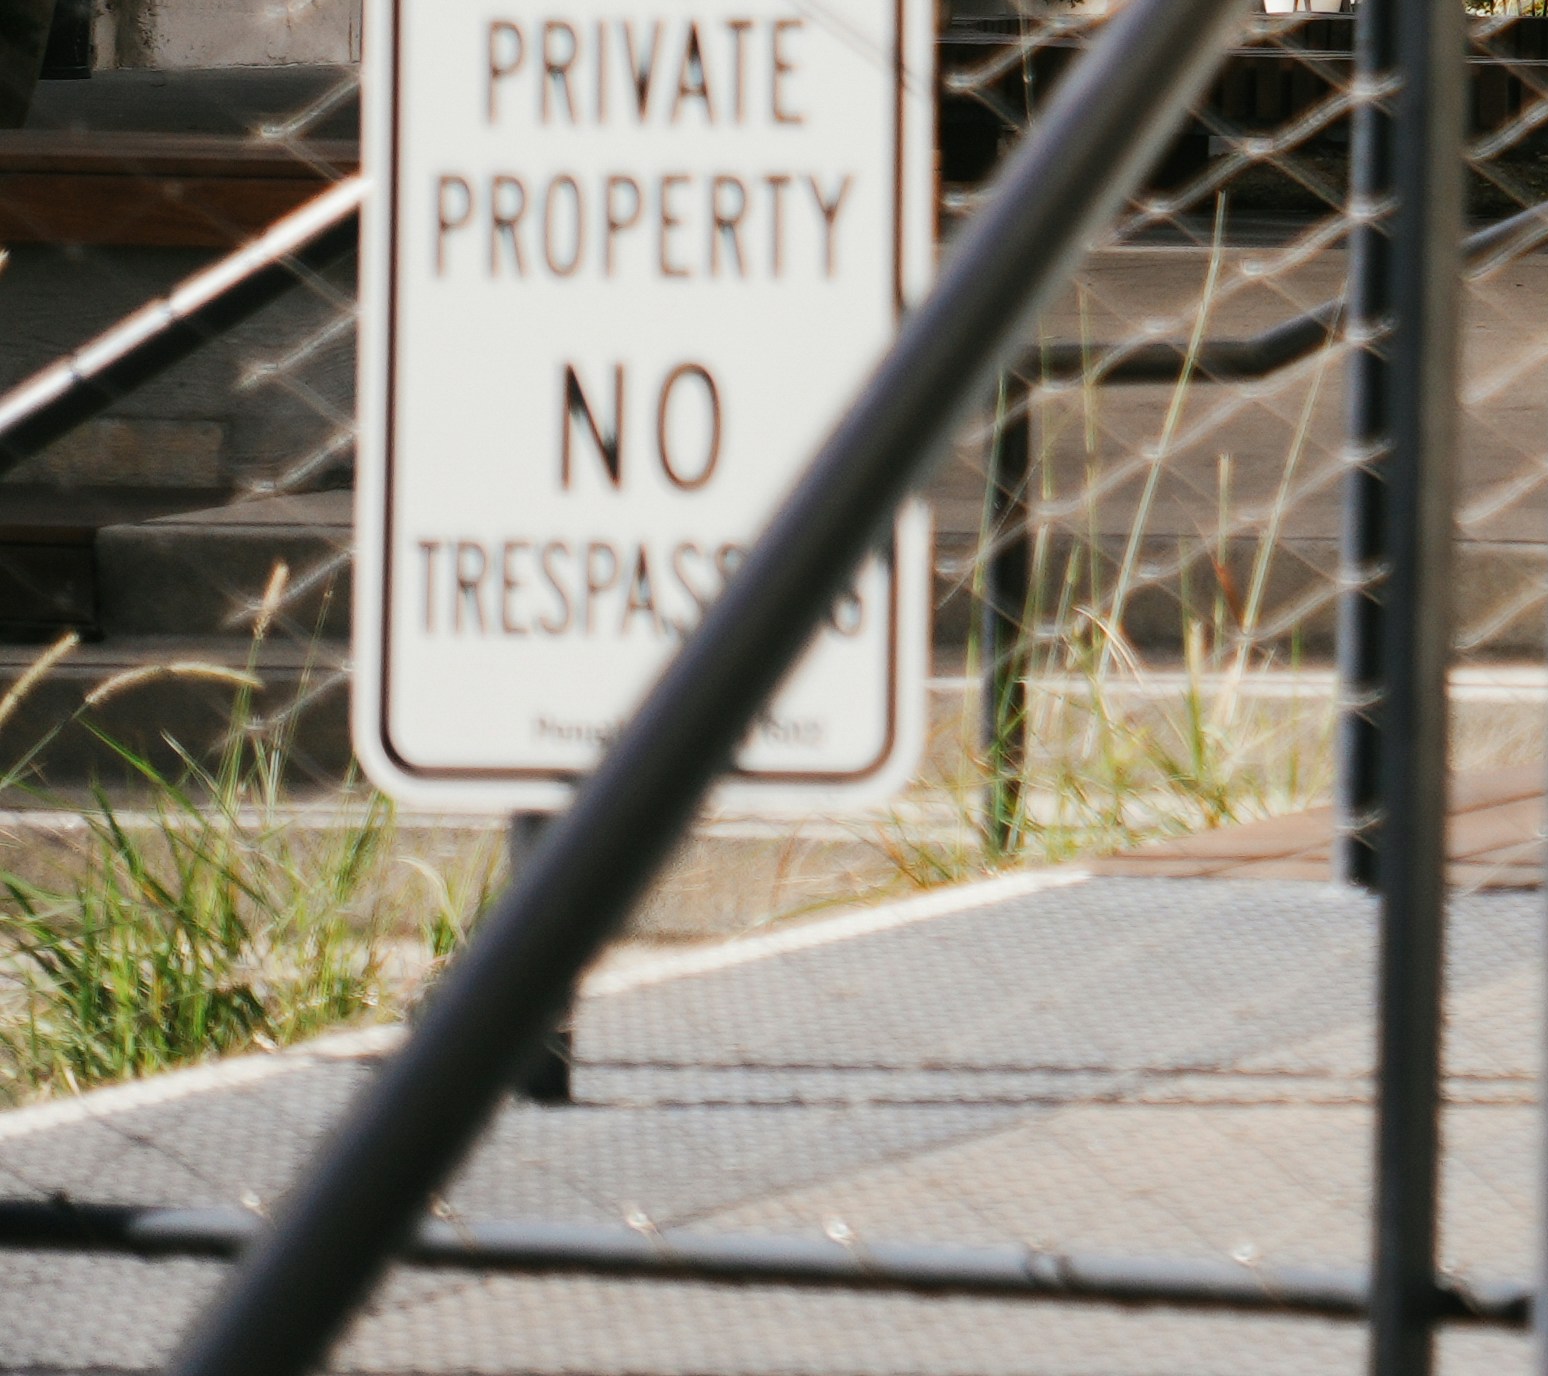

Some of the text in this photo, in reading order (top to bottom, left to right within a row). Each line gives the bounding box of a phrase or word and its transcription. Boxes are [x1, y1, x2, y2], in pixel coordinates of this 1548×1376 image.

[482, 17, 810, 127] PRIVATE
[431, 171, 856, 281] PROPERTY
[558, 359, 726, 494] NO
[417, 537, 865, 639] TRESPAS
